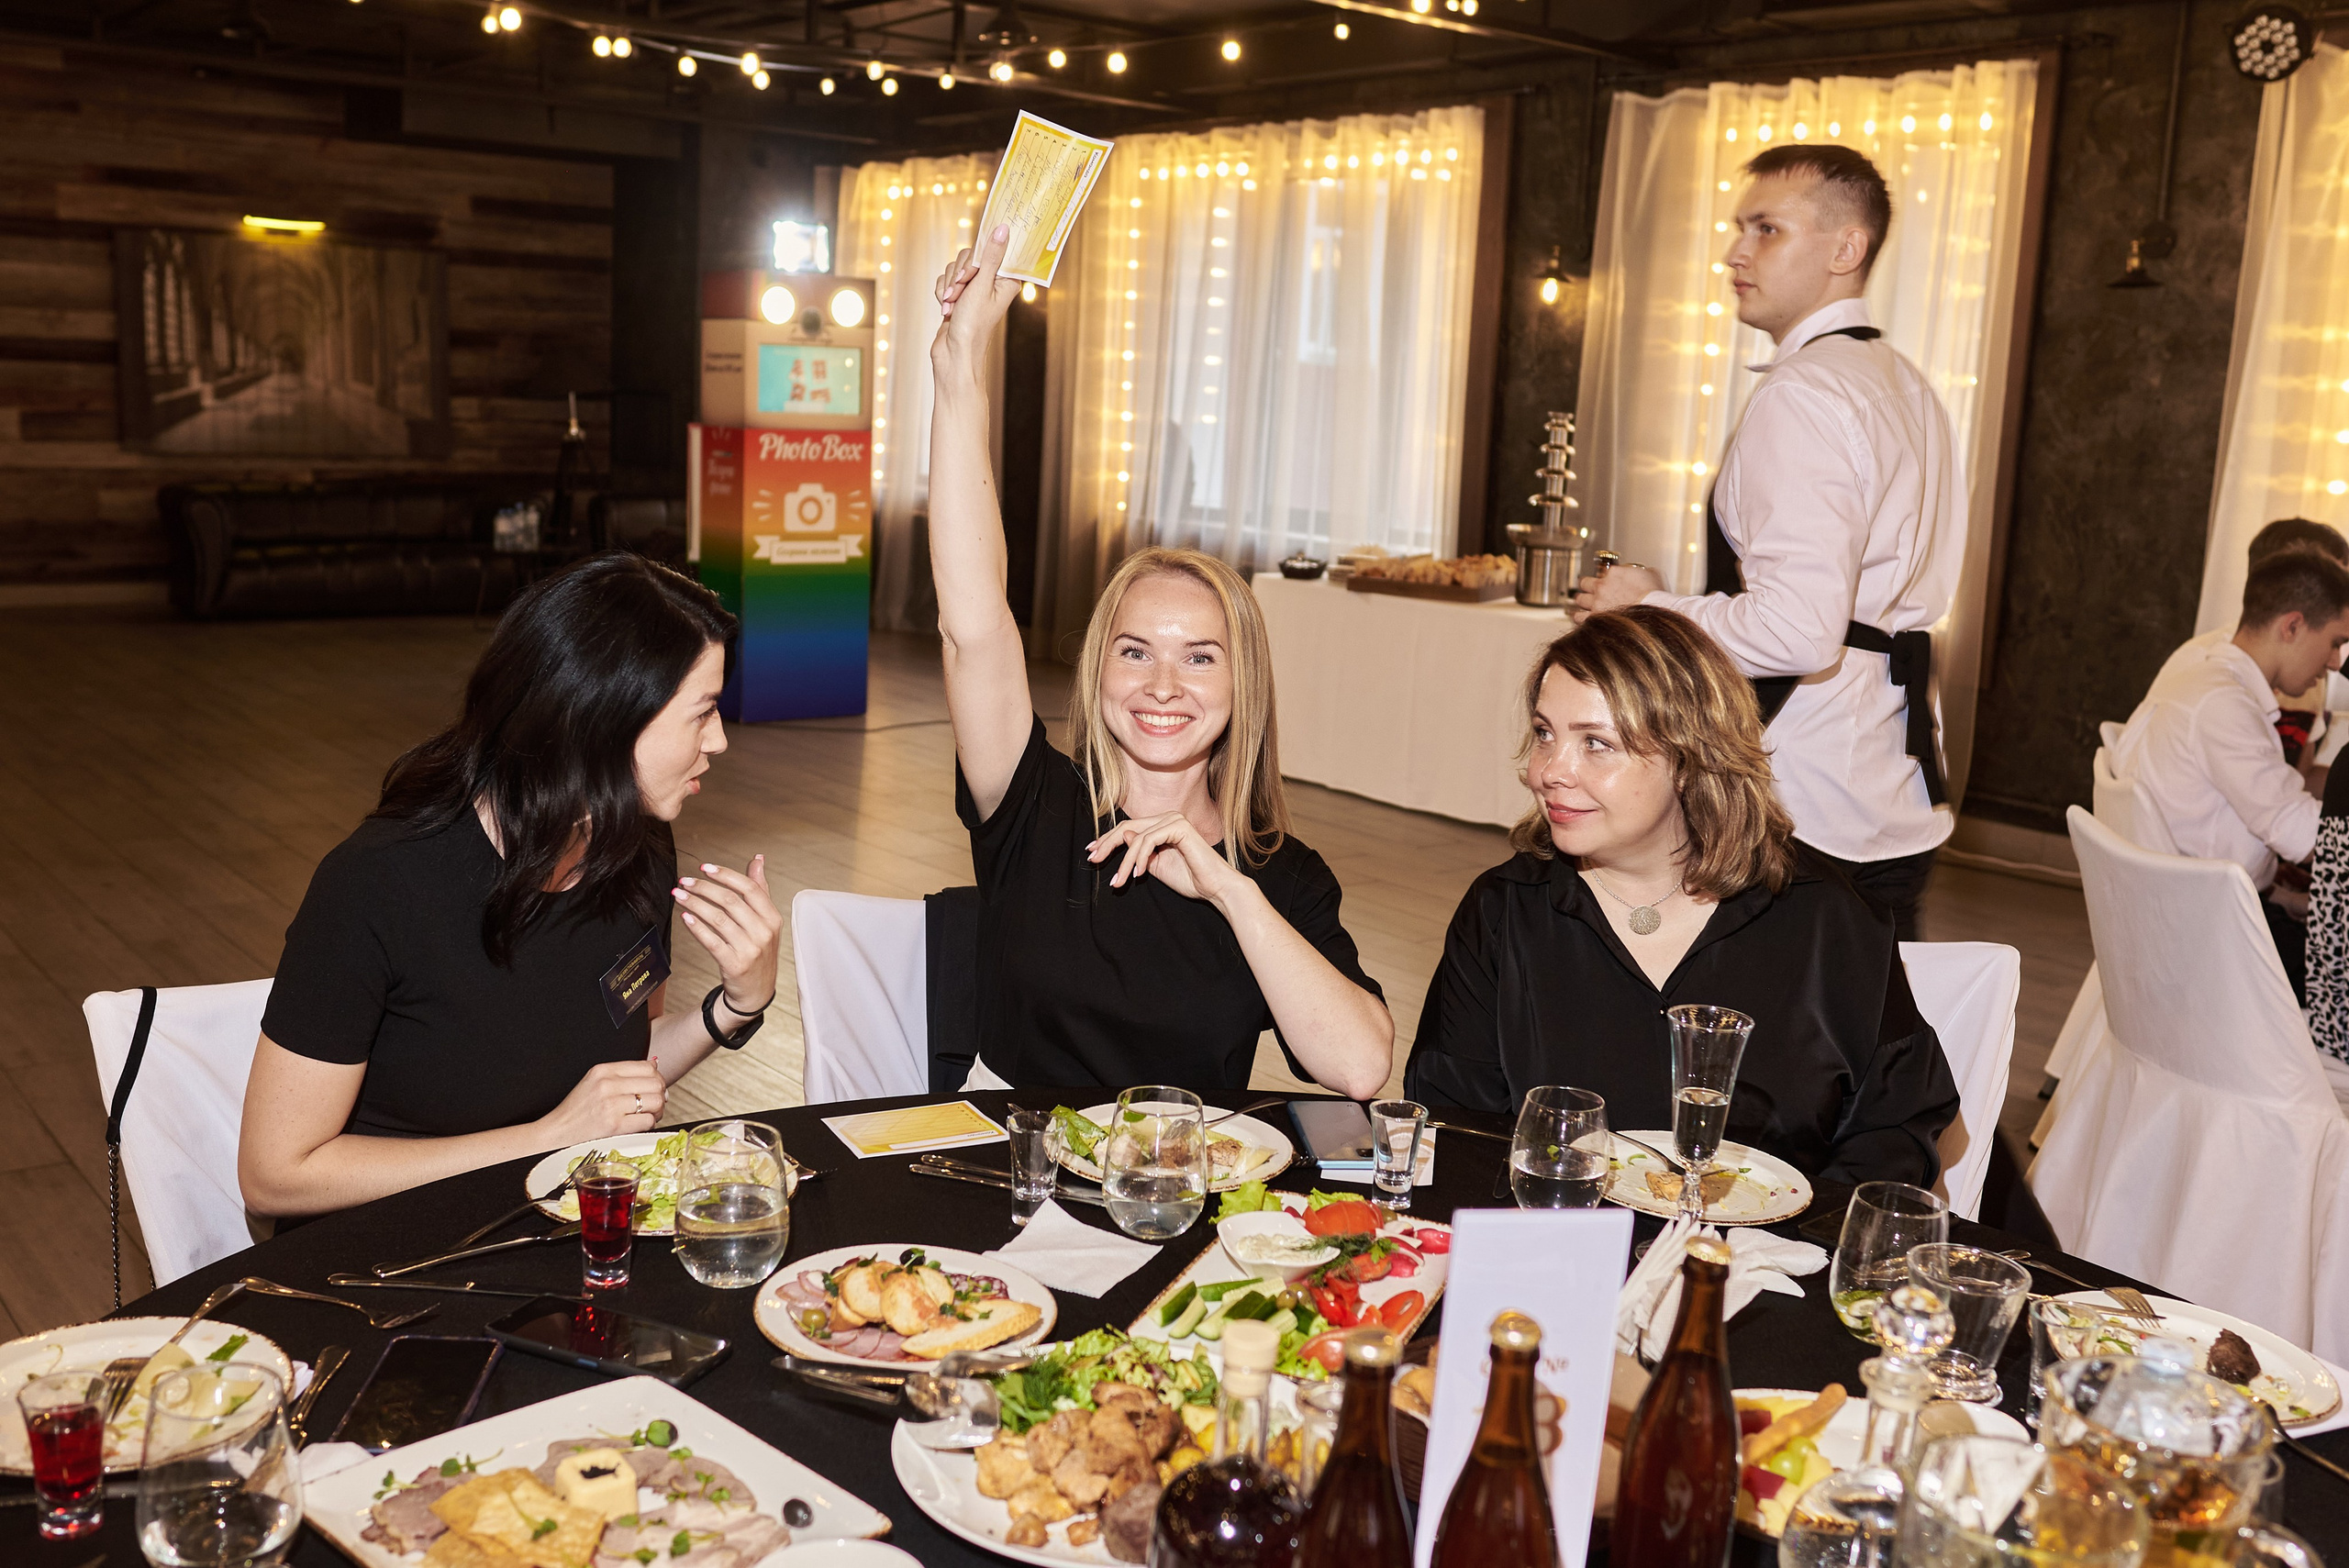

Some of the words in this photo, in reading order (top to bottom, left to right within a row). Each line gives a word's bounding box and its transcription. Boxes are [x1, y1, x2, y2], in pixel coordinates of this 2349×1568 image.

[1083, 151, 1098, 178] Команда
[622, 987, 632, 1000] Яна
[631, 970, 651, 991] Петрова
